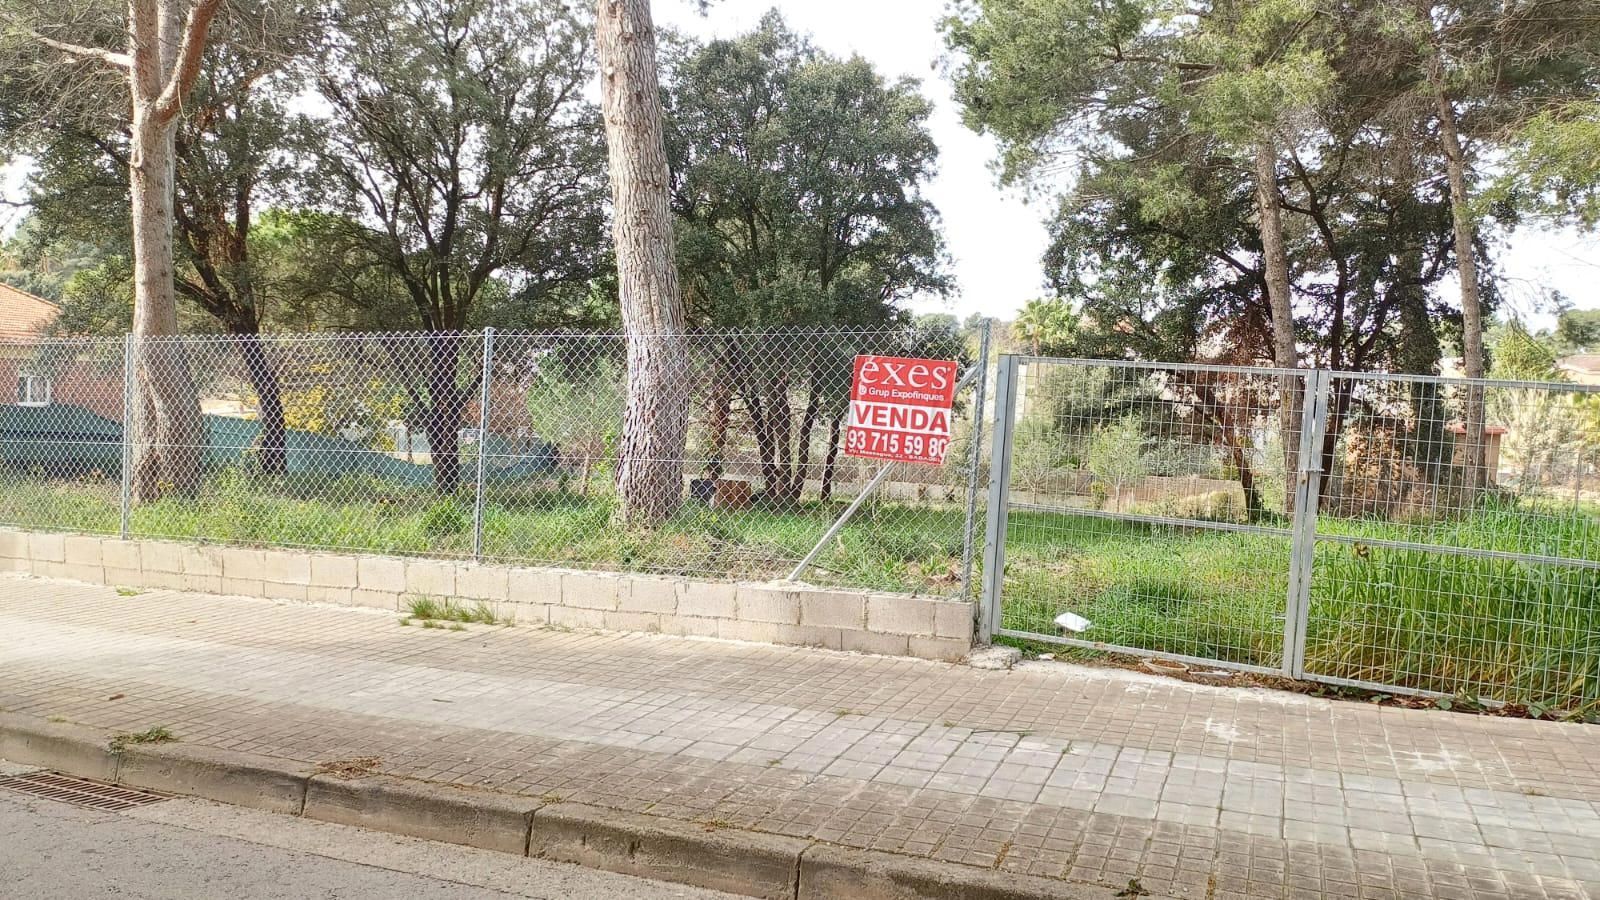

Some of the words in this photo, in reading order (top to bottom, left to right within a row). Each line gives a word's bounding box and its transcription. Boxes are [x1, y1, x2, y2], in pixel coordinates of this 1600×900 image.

[869, 387, 890, 398] Grup
[891, 389, 944, 402] Expofinques
[855, 404, 948, 432] VENDA
[848, 430, 866, 450] 93
[871, 432, 899, 453] 715
[904, 435, 924, 456] 59
[928, 437, 947, 457] 80
